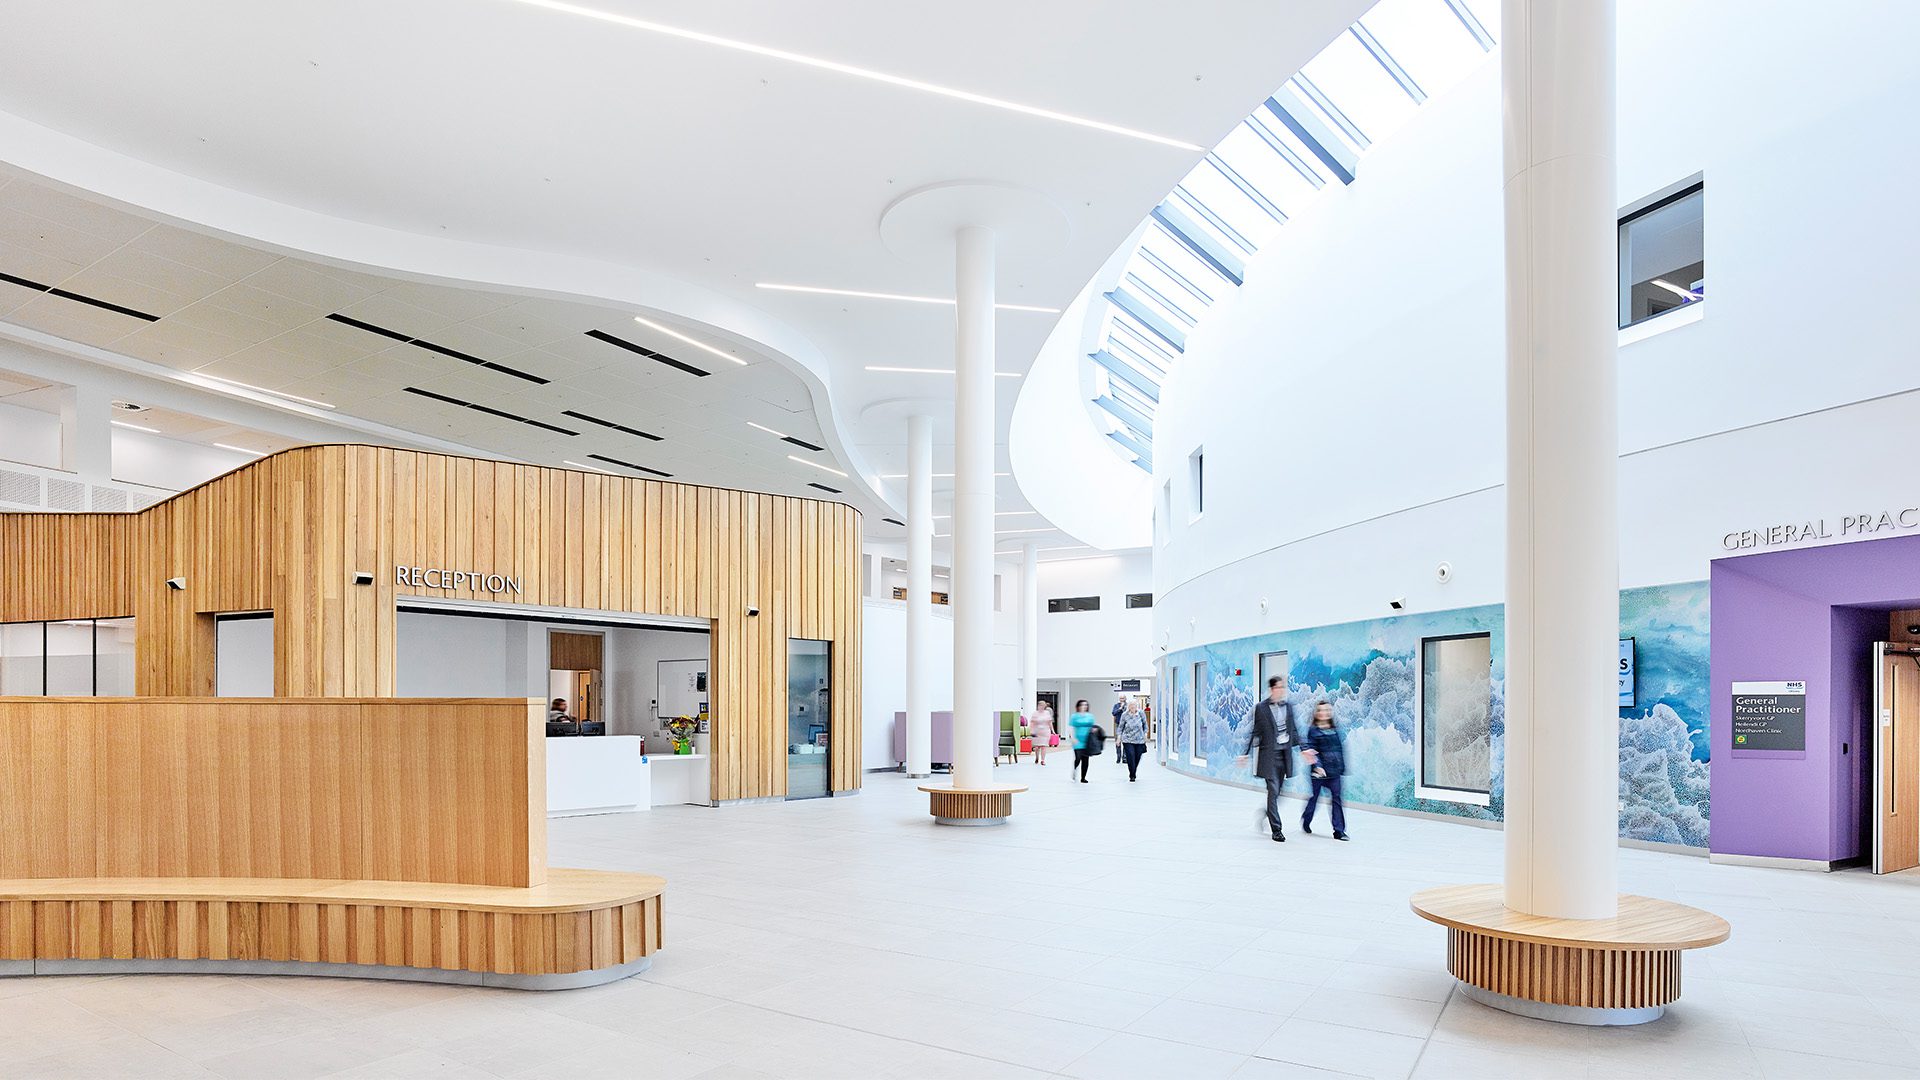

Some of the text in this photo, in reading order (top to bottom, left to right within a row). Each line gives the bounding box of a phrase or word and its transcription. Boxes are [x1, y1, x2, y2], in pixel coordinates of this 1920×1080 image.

[1723, 507, 1919, 550] GENERAL PRAC
[396, 565, 521, 594] RECEPTION
[1736, 697, 1777, 705] General
